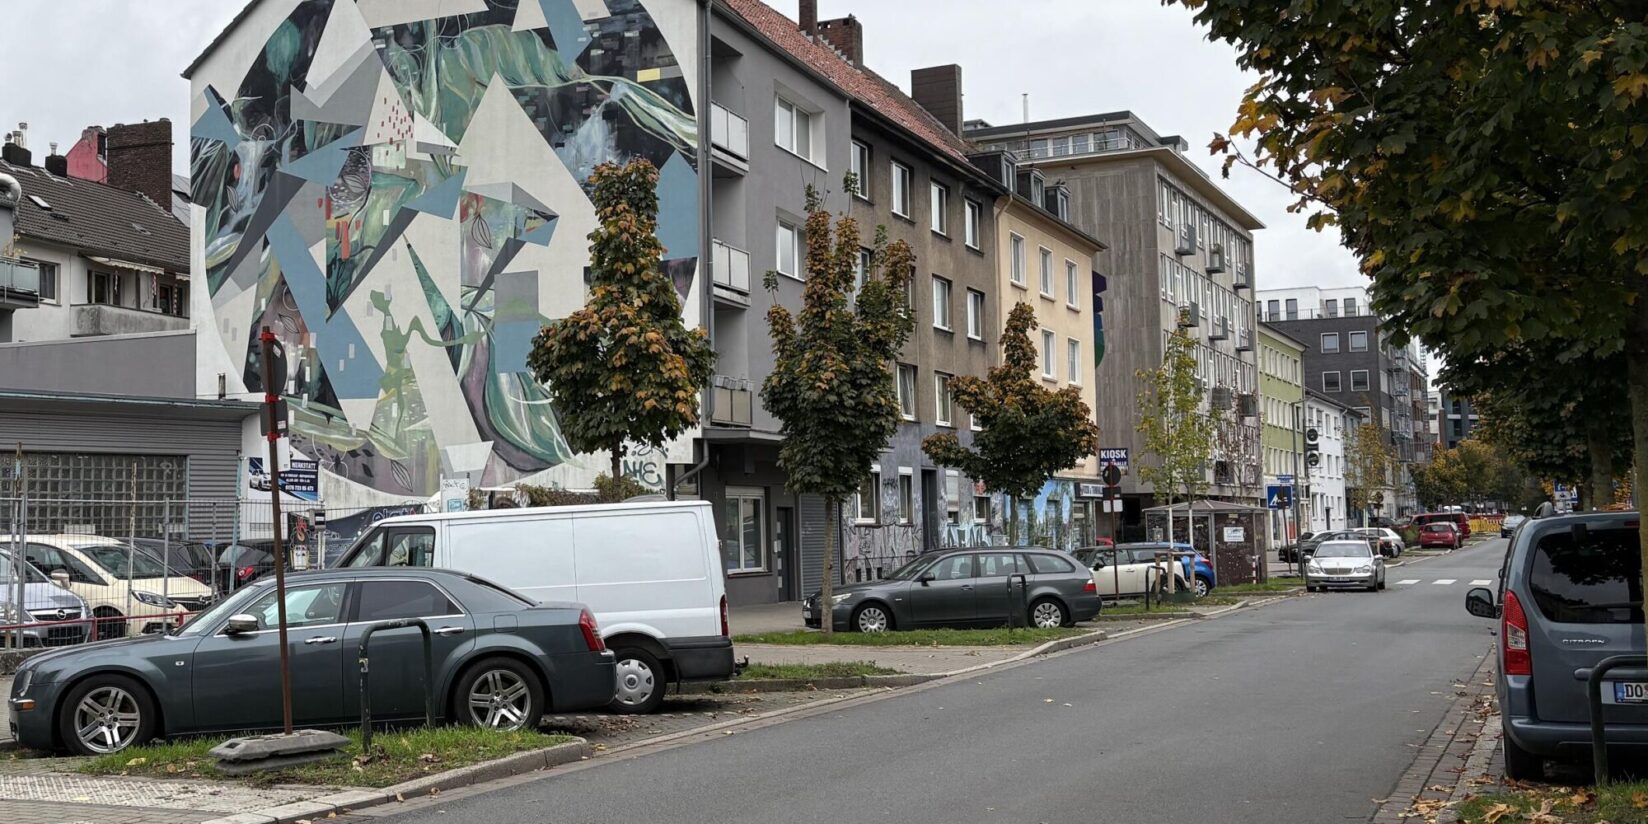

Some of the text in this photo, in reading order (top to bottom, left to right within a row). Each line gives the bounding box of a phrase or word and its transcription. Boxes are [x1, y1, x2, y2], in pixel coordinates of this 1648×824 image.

[1100, 450, 1126, 458] KIOSK
[291, 461, 316, 469] WERKSTATT
[1624, 684, 1643, 698] DO
